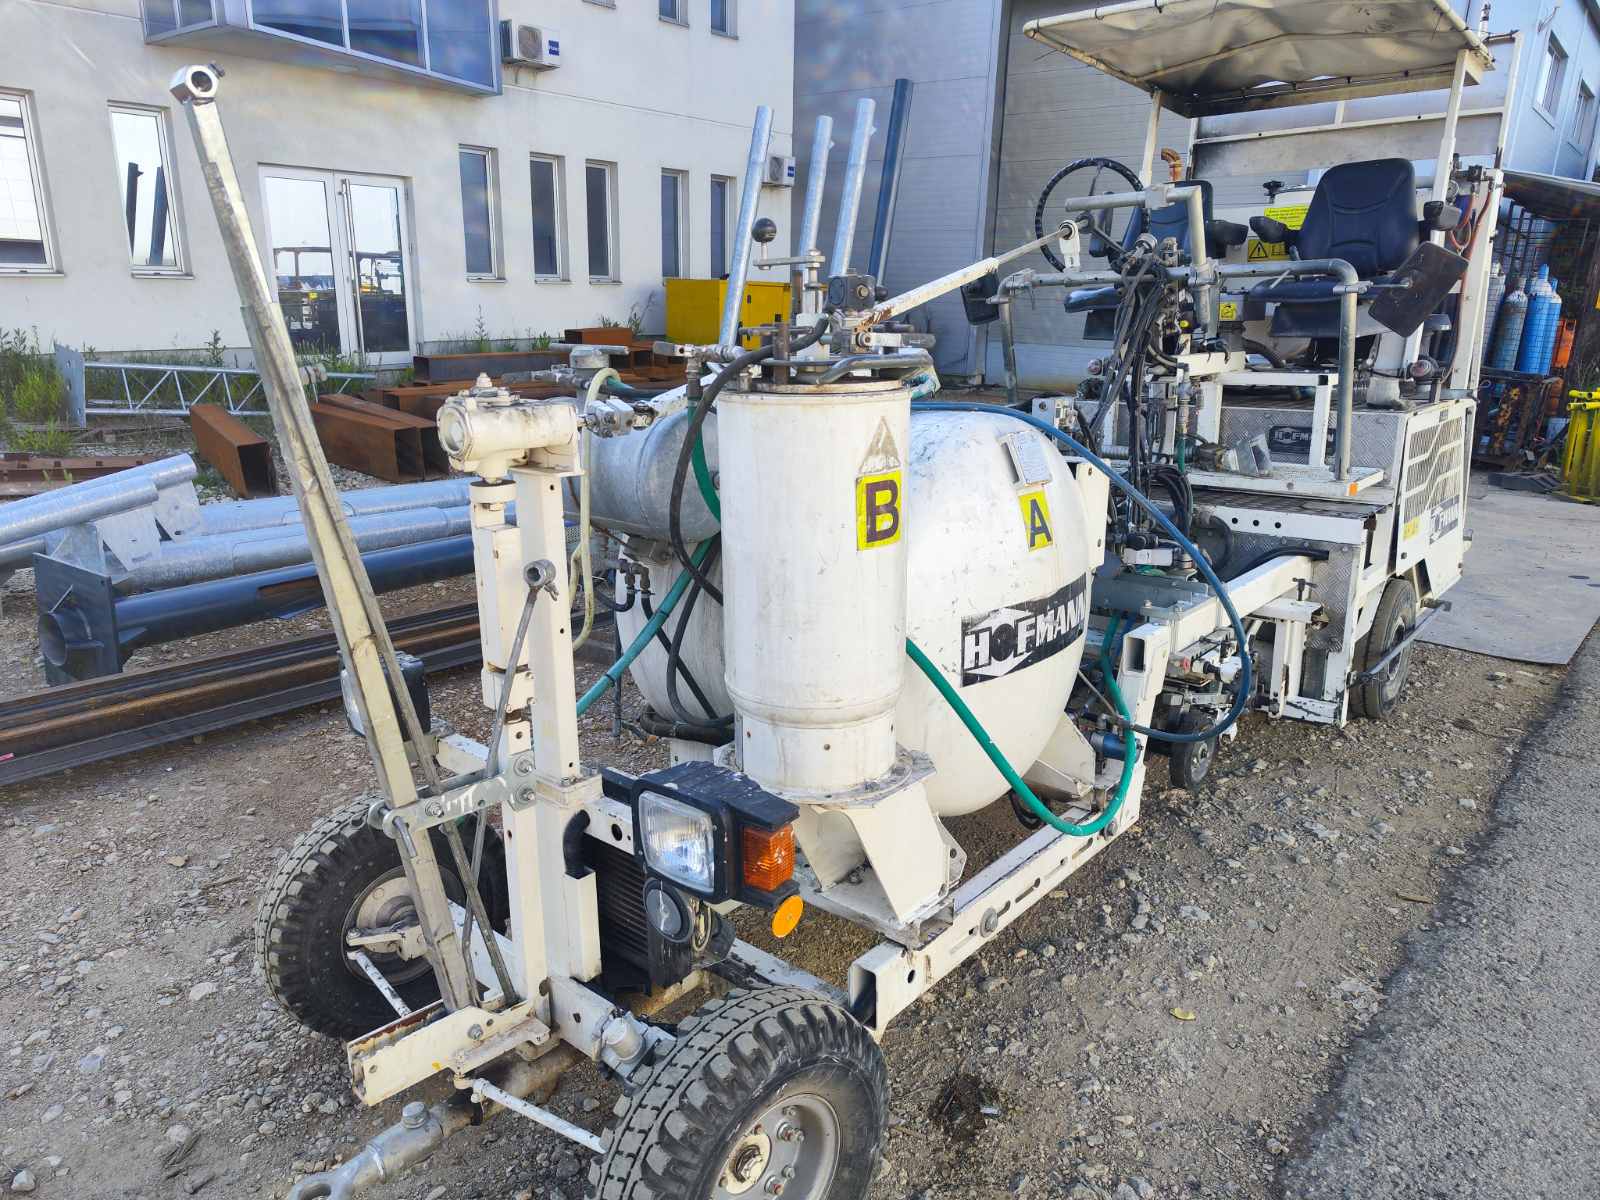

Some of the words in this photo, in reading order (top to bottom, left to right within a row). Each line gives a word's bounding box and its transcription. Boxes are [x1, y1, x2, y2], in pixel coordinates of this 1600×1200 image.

[1274, 430, 1335, 442] HOFMN
[865, 479, 899, 543] B
[1030, 498, 1053, 547] A
[963, 592, 1086, 670] HOFMANN
